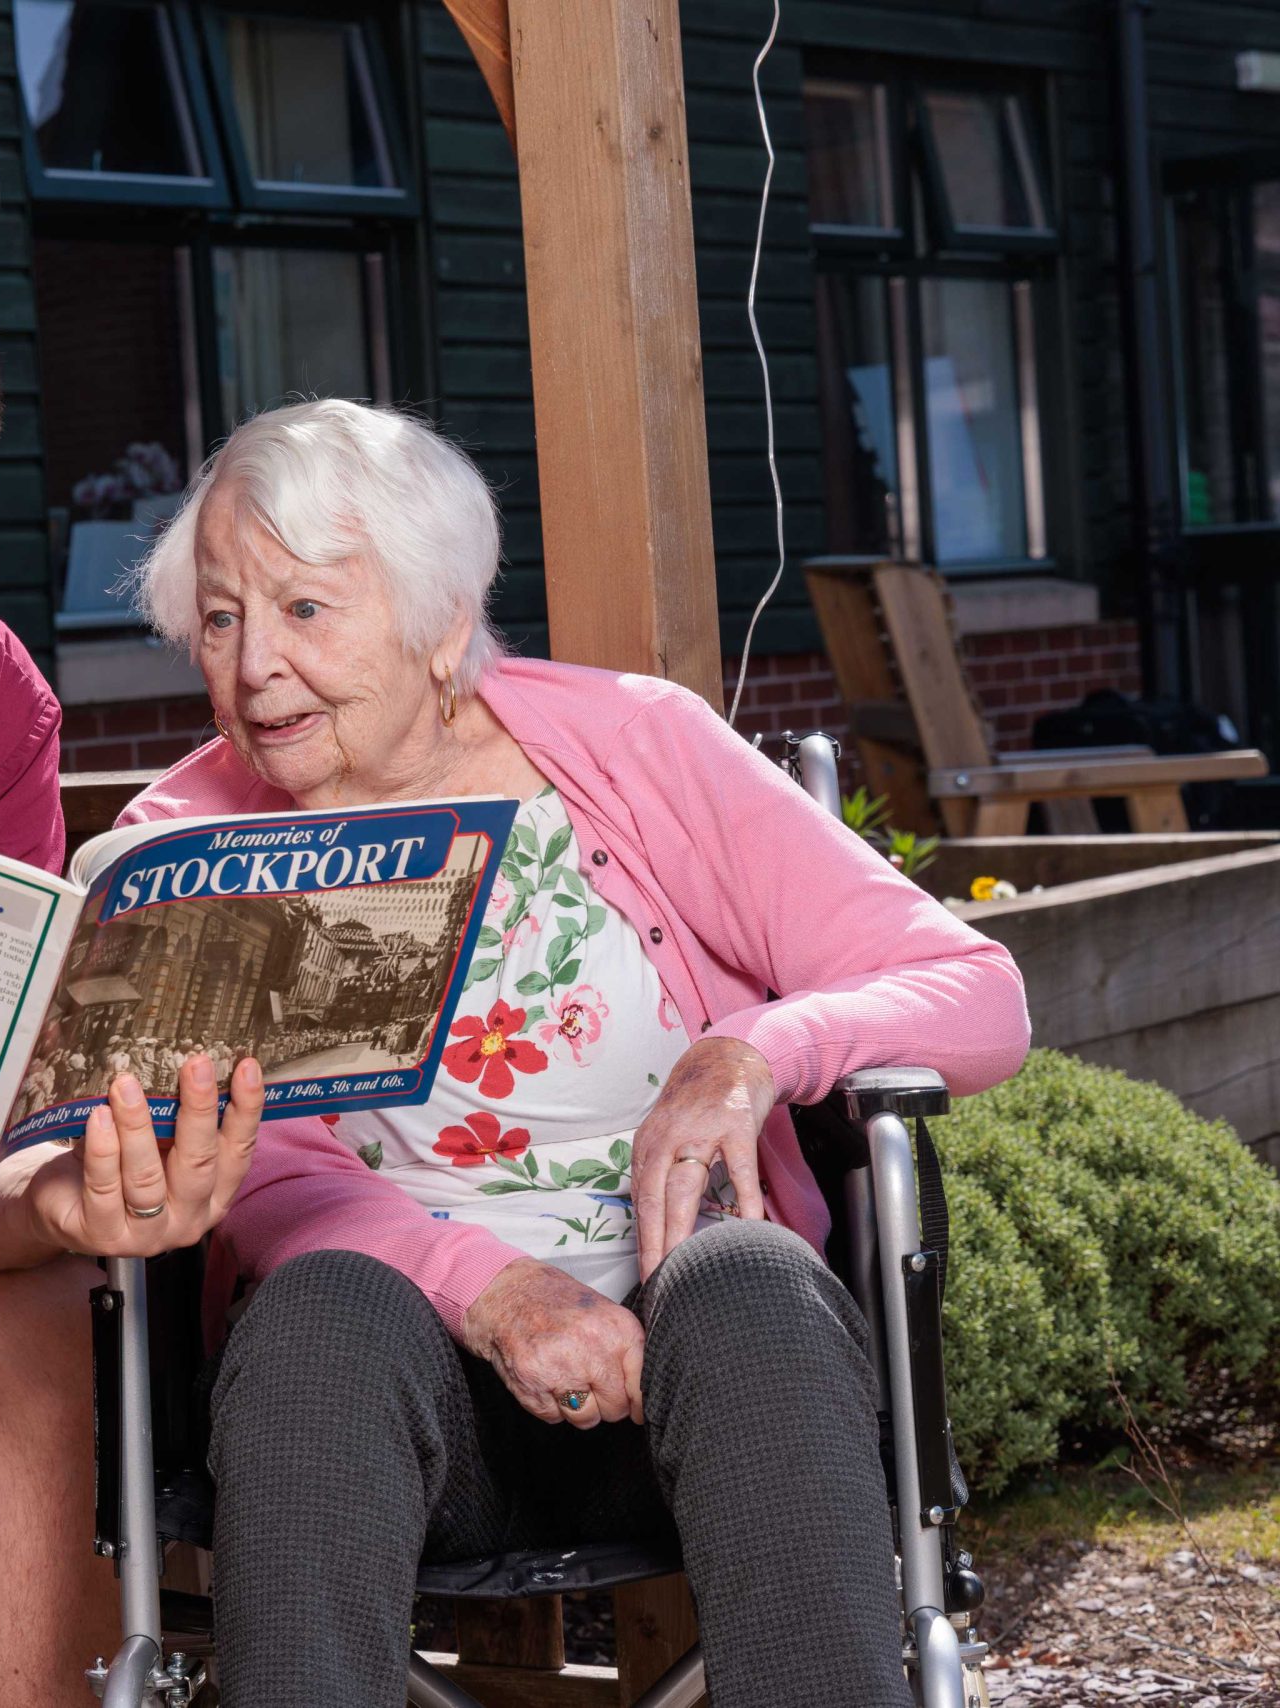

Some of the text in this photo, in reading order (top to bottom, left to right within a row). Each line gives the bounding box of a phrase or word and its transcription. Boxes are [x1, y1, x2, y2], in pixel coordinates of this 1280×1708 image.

[207, 822, 347, 850] Memories of
[113, 837, 425, 917] STOCKPORT
[9, 945, 32, 958] much
[6, 979, 21, 992] 150
[7, 1107, 71, 1142] Wonderfully
[148, 1102, 175, 1116] ocal
[287, 1085, 324, 1099] 1940s,
[329, 1082, 351, 1094] 50s
[354, 1078, 377, 1091] and
[381, 1075, 405, 1088] 60s.
